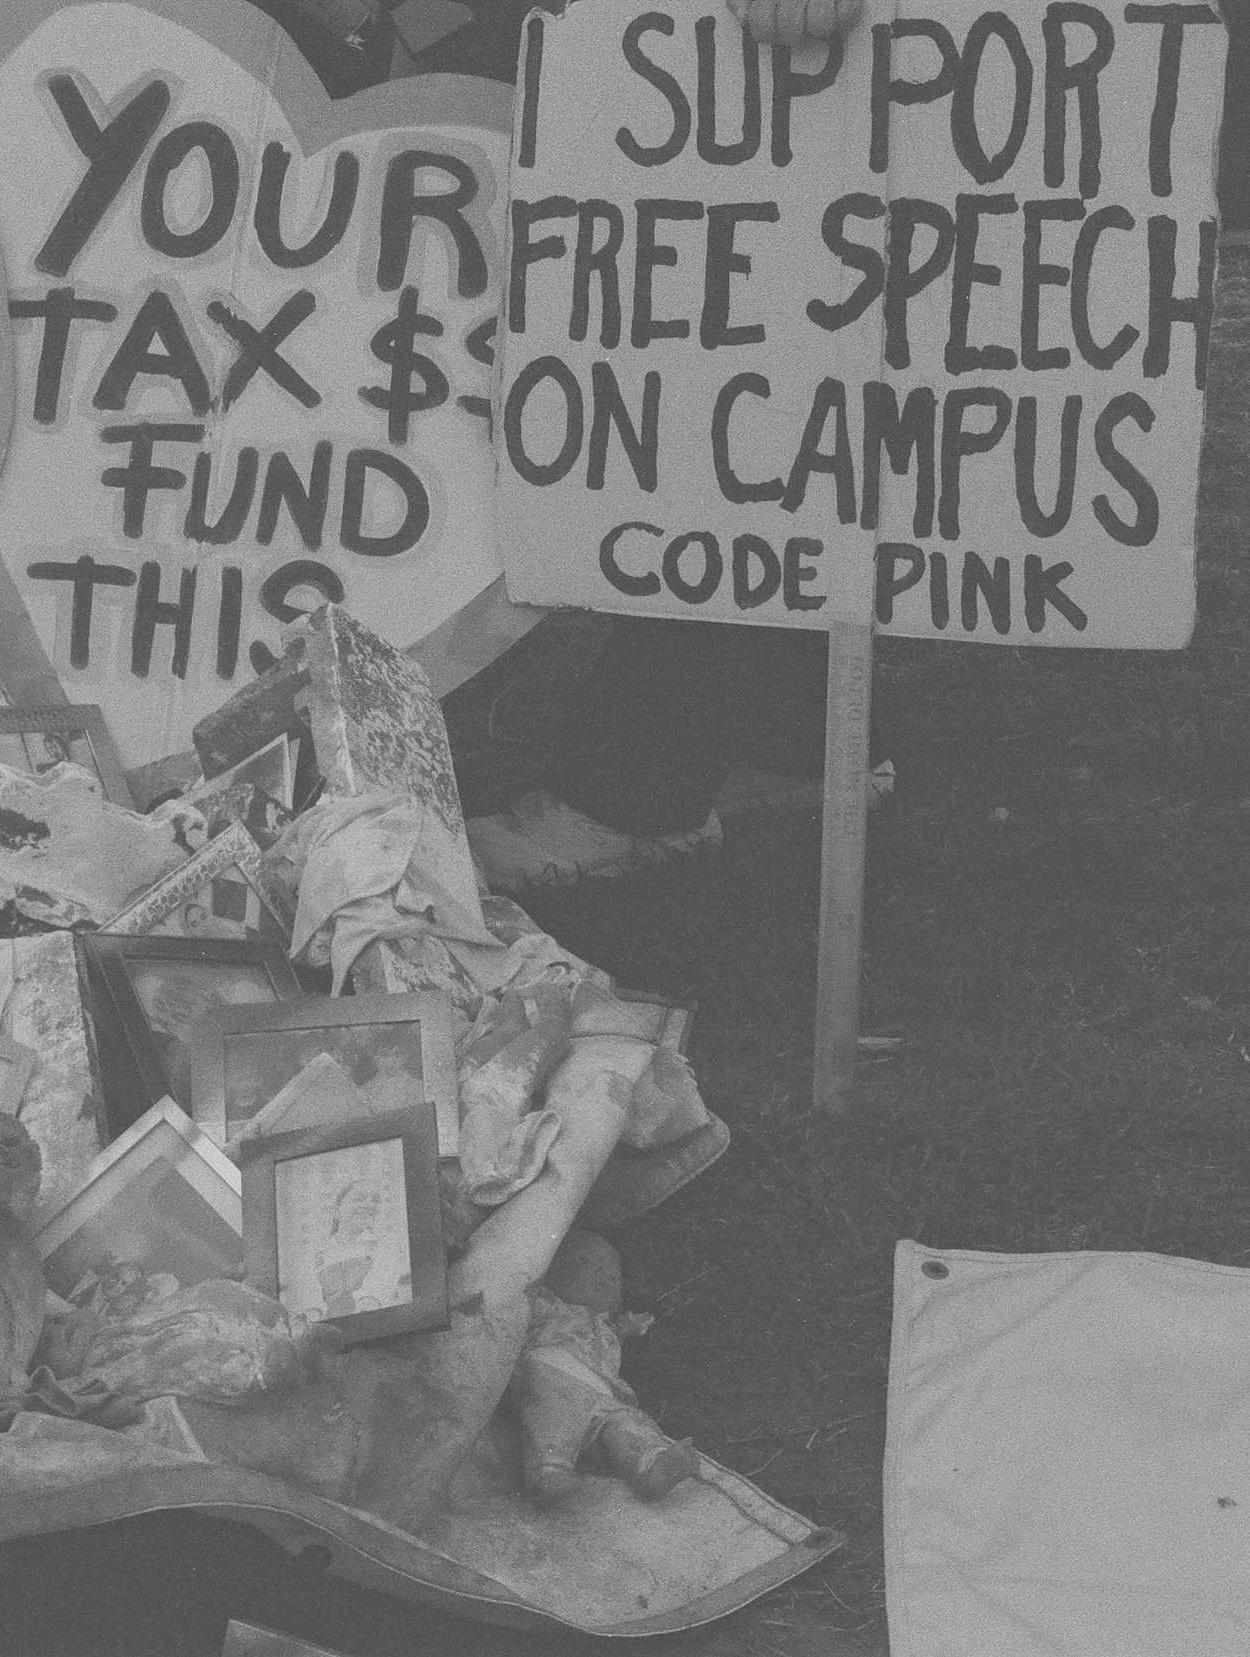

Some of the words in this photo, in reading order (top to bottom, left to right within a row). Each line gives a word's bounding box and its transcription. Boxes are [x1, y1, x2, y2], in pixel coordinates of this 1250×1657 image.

[518, 15, 545, 168] I
[614, 3, 1225, 199] SUPPORT
[34, 72, 490, 299] YOUR
[9, 284, 323, 426] TAX
[507, 194, 782, 351] FREE
[805, 191, 1222, 392] SPEECH
[98, 421, 433, 558] FUND
[502, 354, 662, 494] ON
[709, 370, 1161, 548] CAMPUS
[24, 554, 346, 681] THIS
[598, 520, 829, 613] CODE
[872, 541, 1090, 636] PINK
